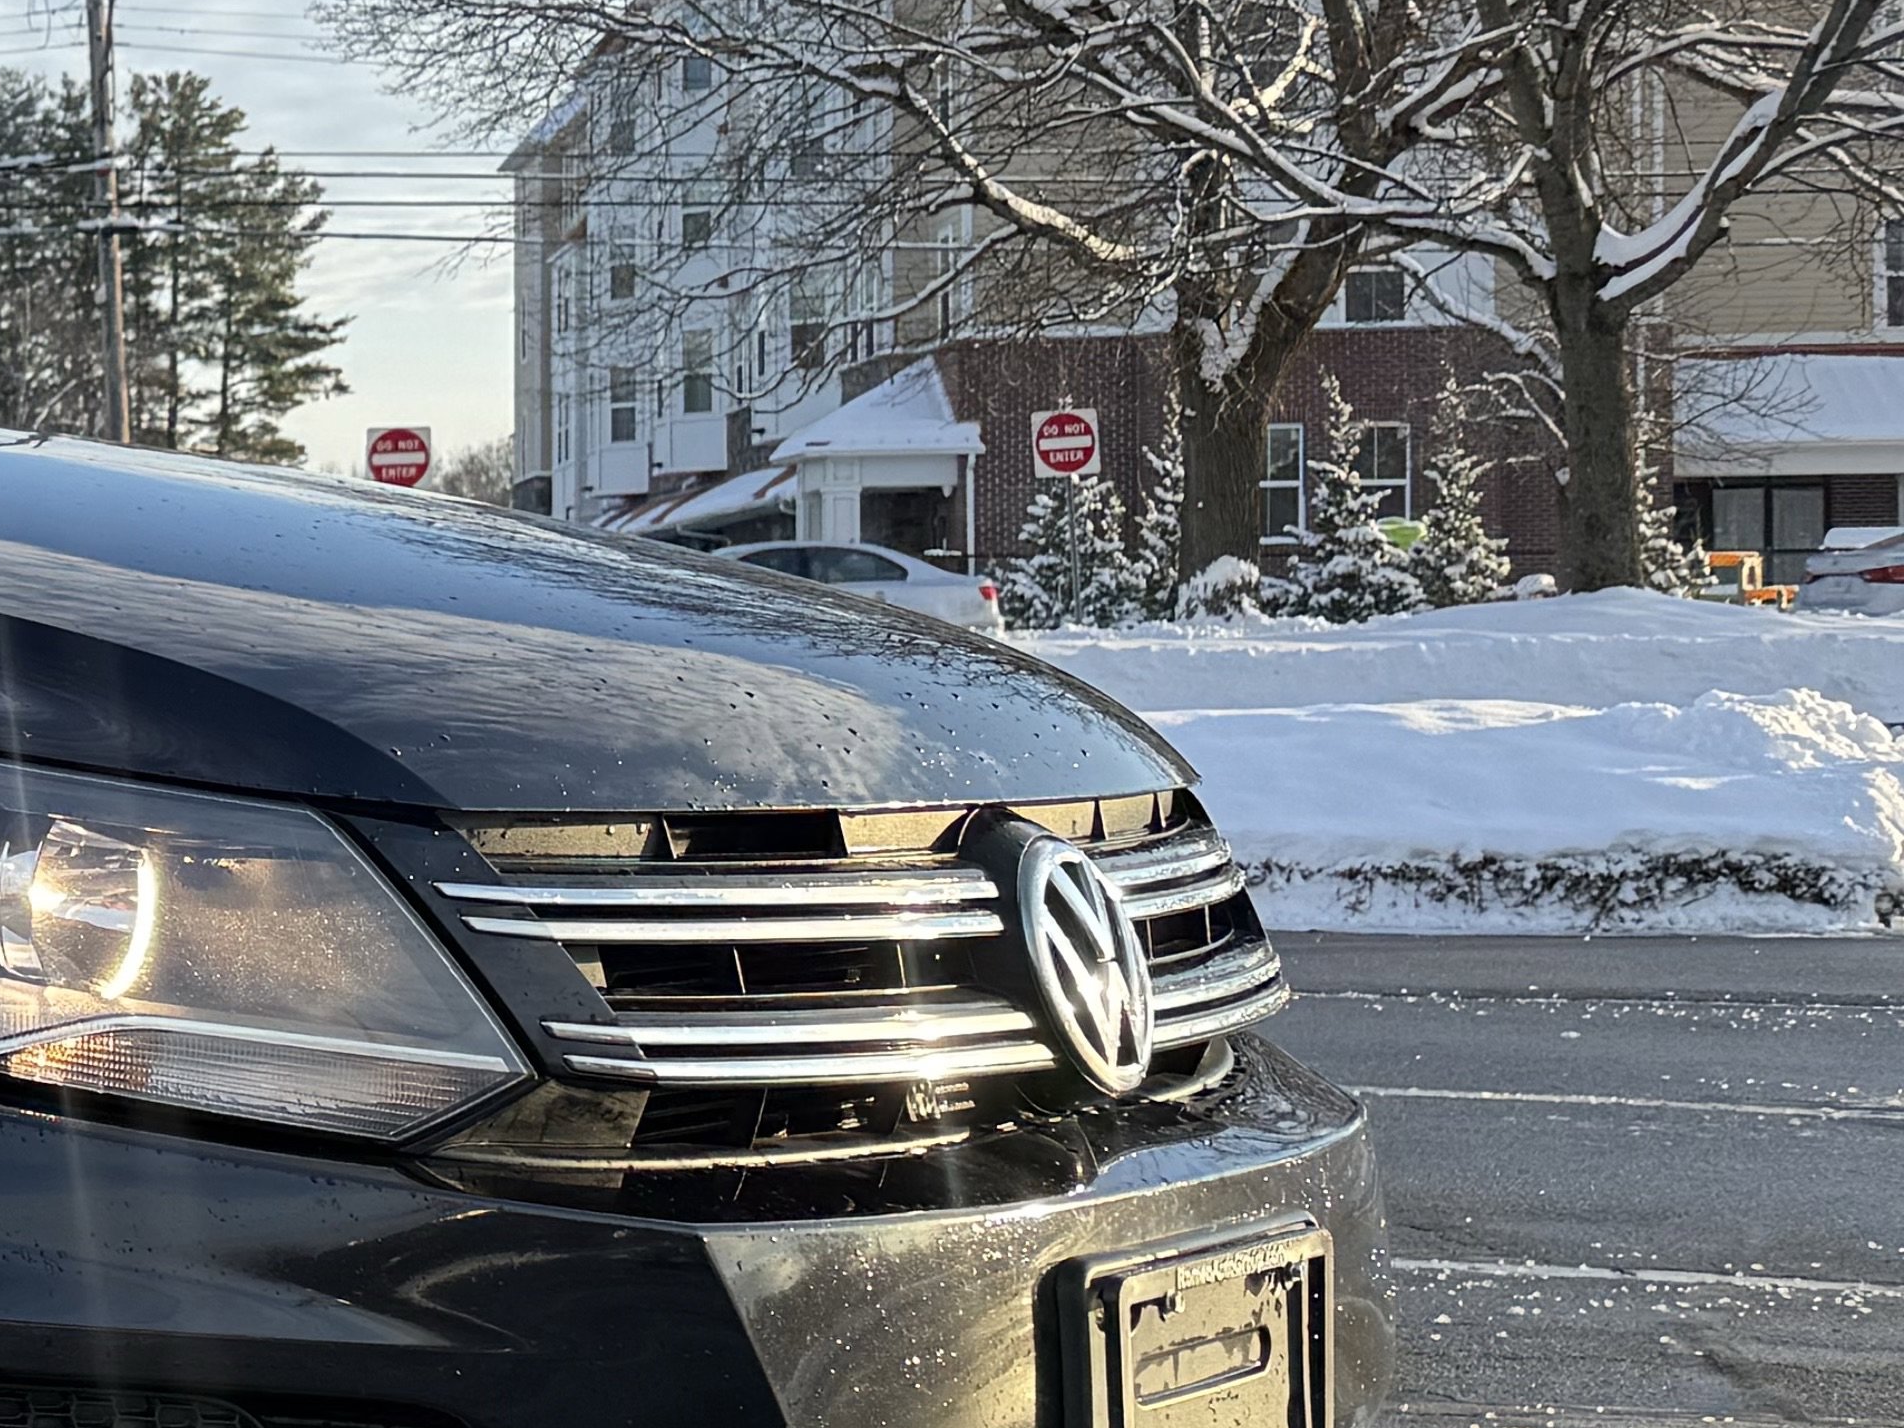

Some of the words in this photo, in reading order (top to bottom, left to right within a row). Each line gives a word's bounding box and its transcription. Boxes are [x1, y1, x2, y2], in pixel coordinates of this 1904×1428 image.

[1042, 425, 1059, 437] DO
[1064, 422, 1086, 435] NOT
[397, 438, 420, 450] NOT
[1049, 449, 1084, 464] ENTER
[381, 466, 417, 481] ENTER
